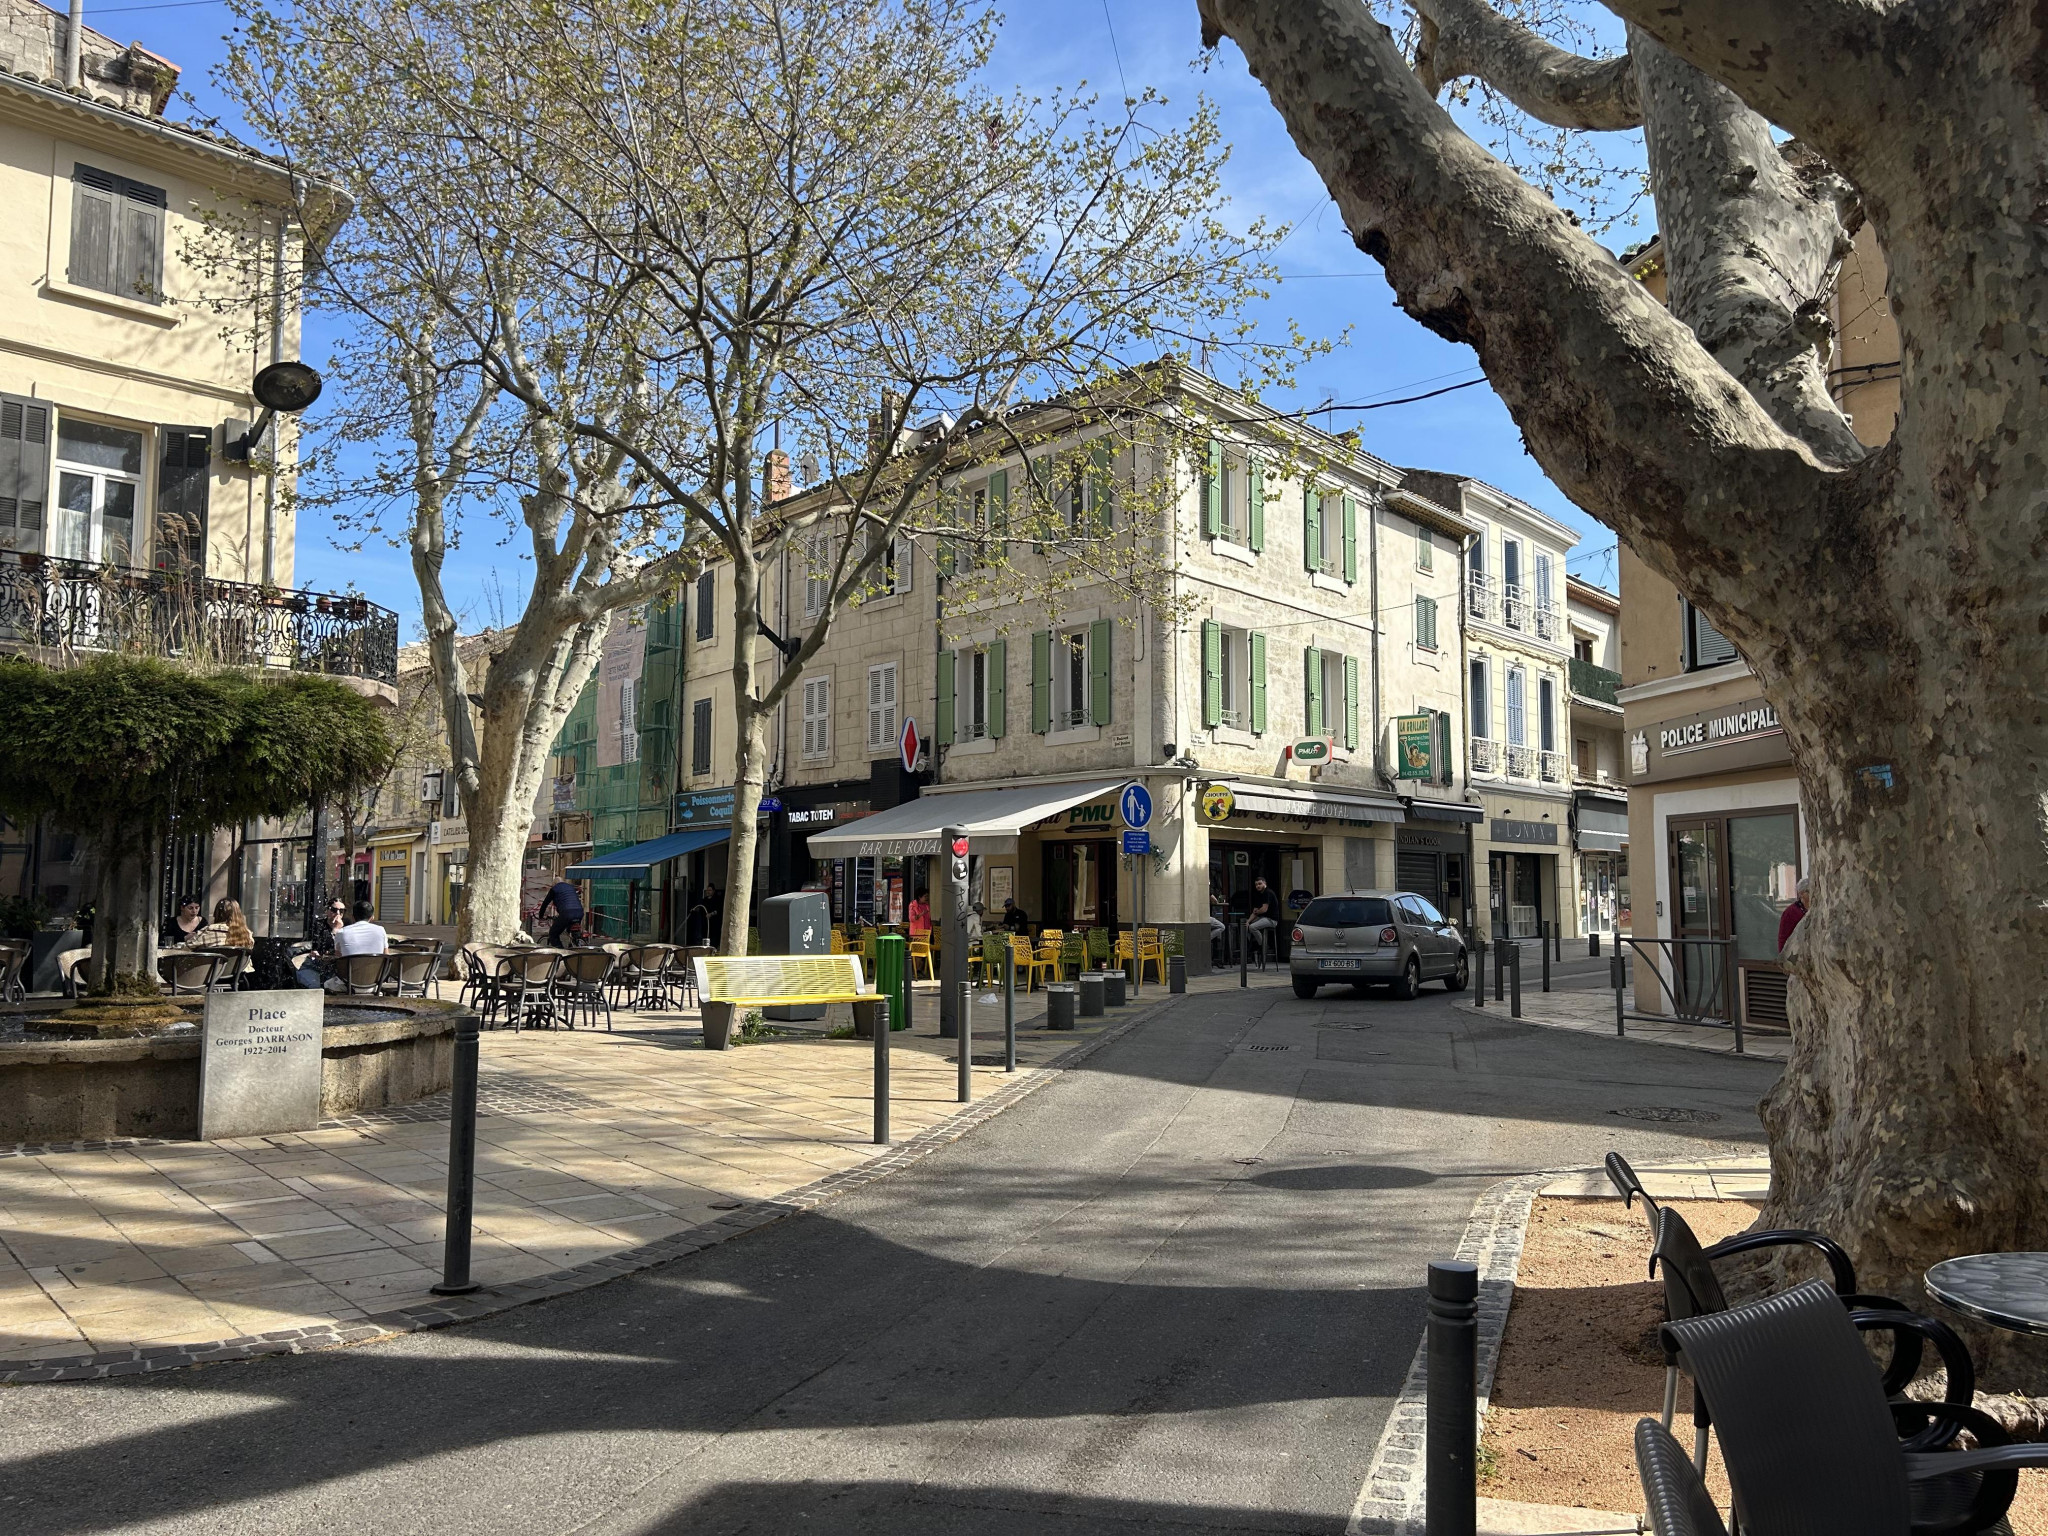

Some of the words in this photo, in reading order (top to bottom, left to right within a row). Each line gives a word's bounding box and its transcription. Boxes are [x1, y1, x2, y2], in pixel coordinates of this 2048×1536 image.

[1407, 720, 1428, 732] GRILLADE
[1661, 723, 1703, 748] POLICE
[691, 792, 735, 807] Poissonnerie
[788, 812, 809, 823] TABAC
[810, 809, 833, 821] TOTEM
[1070, 804, 1115, 823] PMU
[1285, 800, 1305, 812] BAR
[1307, 802, 1317, 815] LE
[1321, 803, 1349, 818] ROYAL
[859, 841, 882, 855] BAR
[887, 841, 902, 855] LE
[248, 1008, 287, 1021] Place
[248, 1025, 284, 1034] Docteur
[216, 1037, 252, 1047] Georges
[256, 1033, 313, 1044] DARRASON
[243, 1045, 287, 1056] 1922-2014
